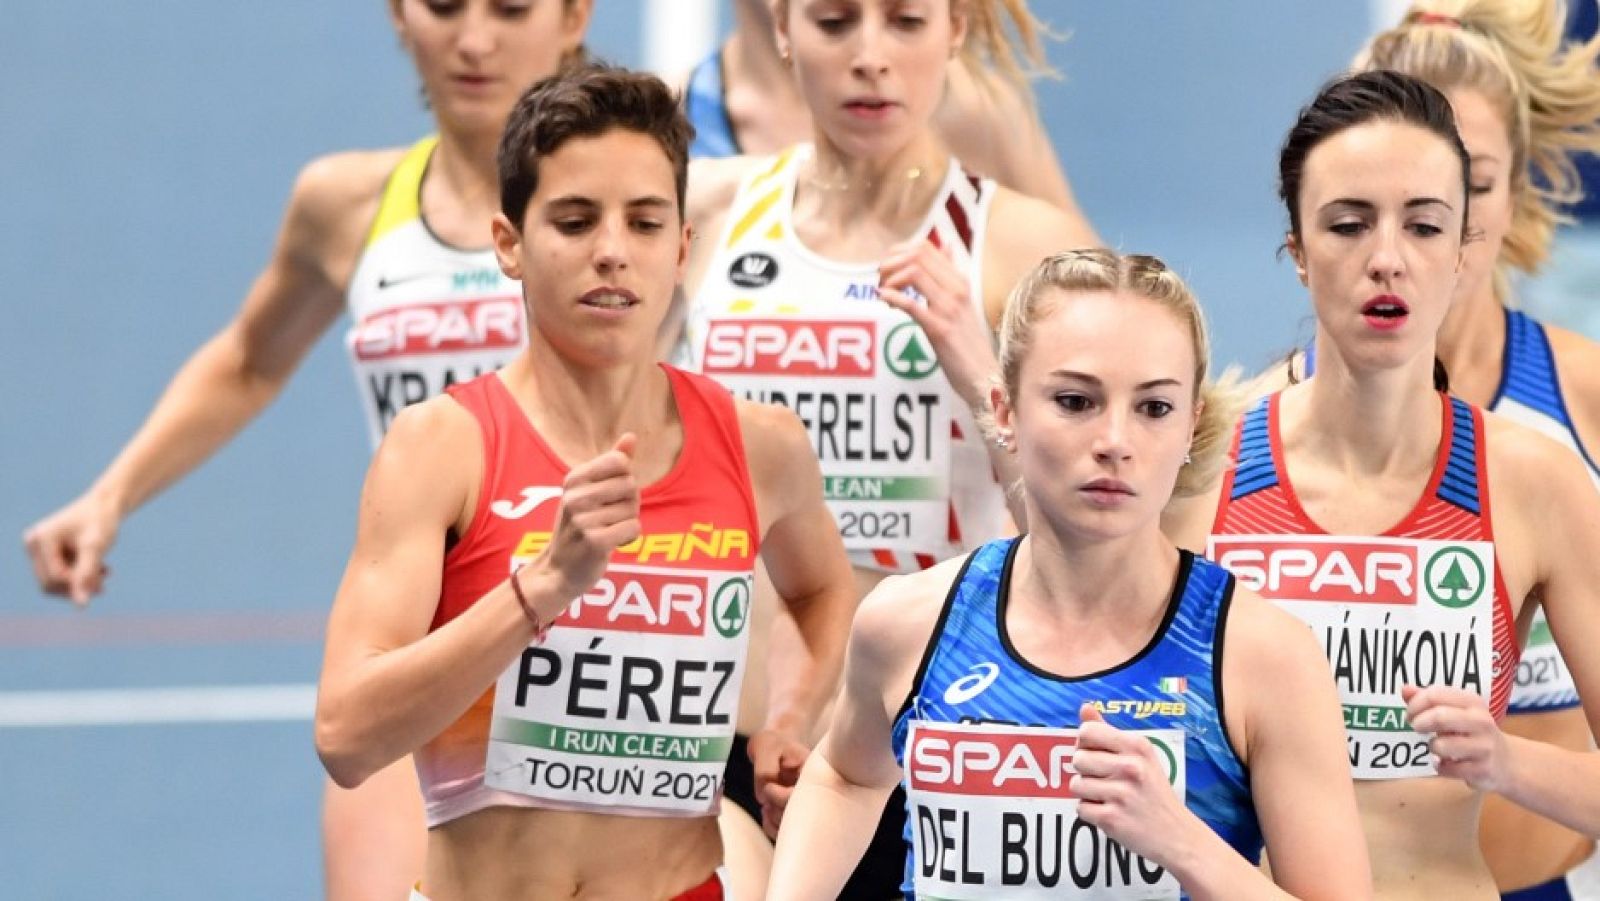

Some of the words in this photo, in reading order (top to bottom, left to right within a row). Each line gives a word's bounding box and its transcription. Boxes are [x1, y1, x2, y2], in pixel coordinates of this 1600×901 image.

[356, 305, 520, 352] SPAR
[706, 326, 872, 370] SPAR
[730, 390, 938, 461] ERELST
[824, 478, 882, 498] LEAN
[514, 522, 749, 562] EAÑA
[840, 511, 911, 538] 2021
[1221, 549, 1413, 596] SPAR
[553, 578, 703, 628] PAR
[514, 637, 735, 725] PÉREZ
[1514, 655, 1559, 687] 021
[1086, 700, 1187, 719] ASTWEB
[550, 728, 557, 746] I
[564, 730, 617, 753] RUN
[1370, 741, 1430, 769] 202
[526, 757, 644, 796] TORUŃ
[651, 770, 719, 801] 2021
[917, 804, 984, 885] DEL
